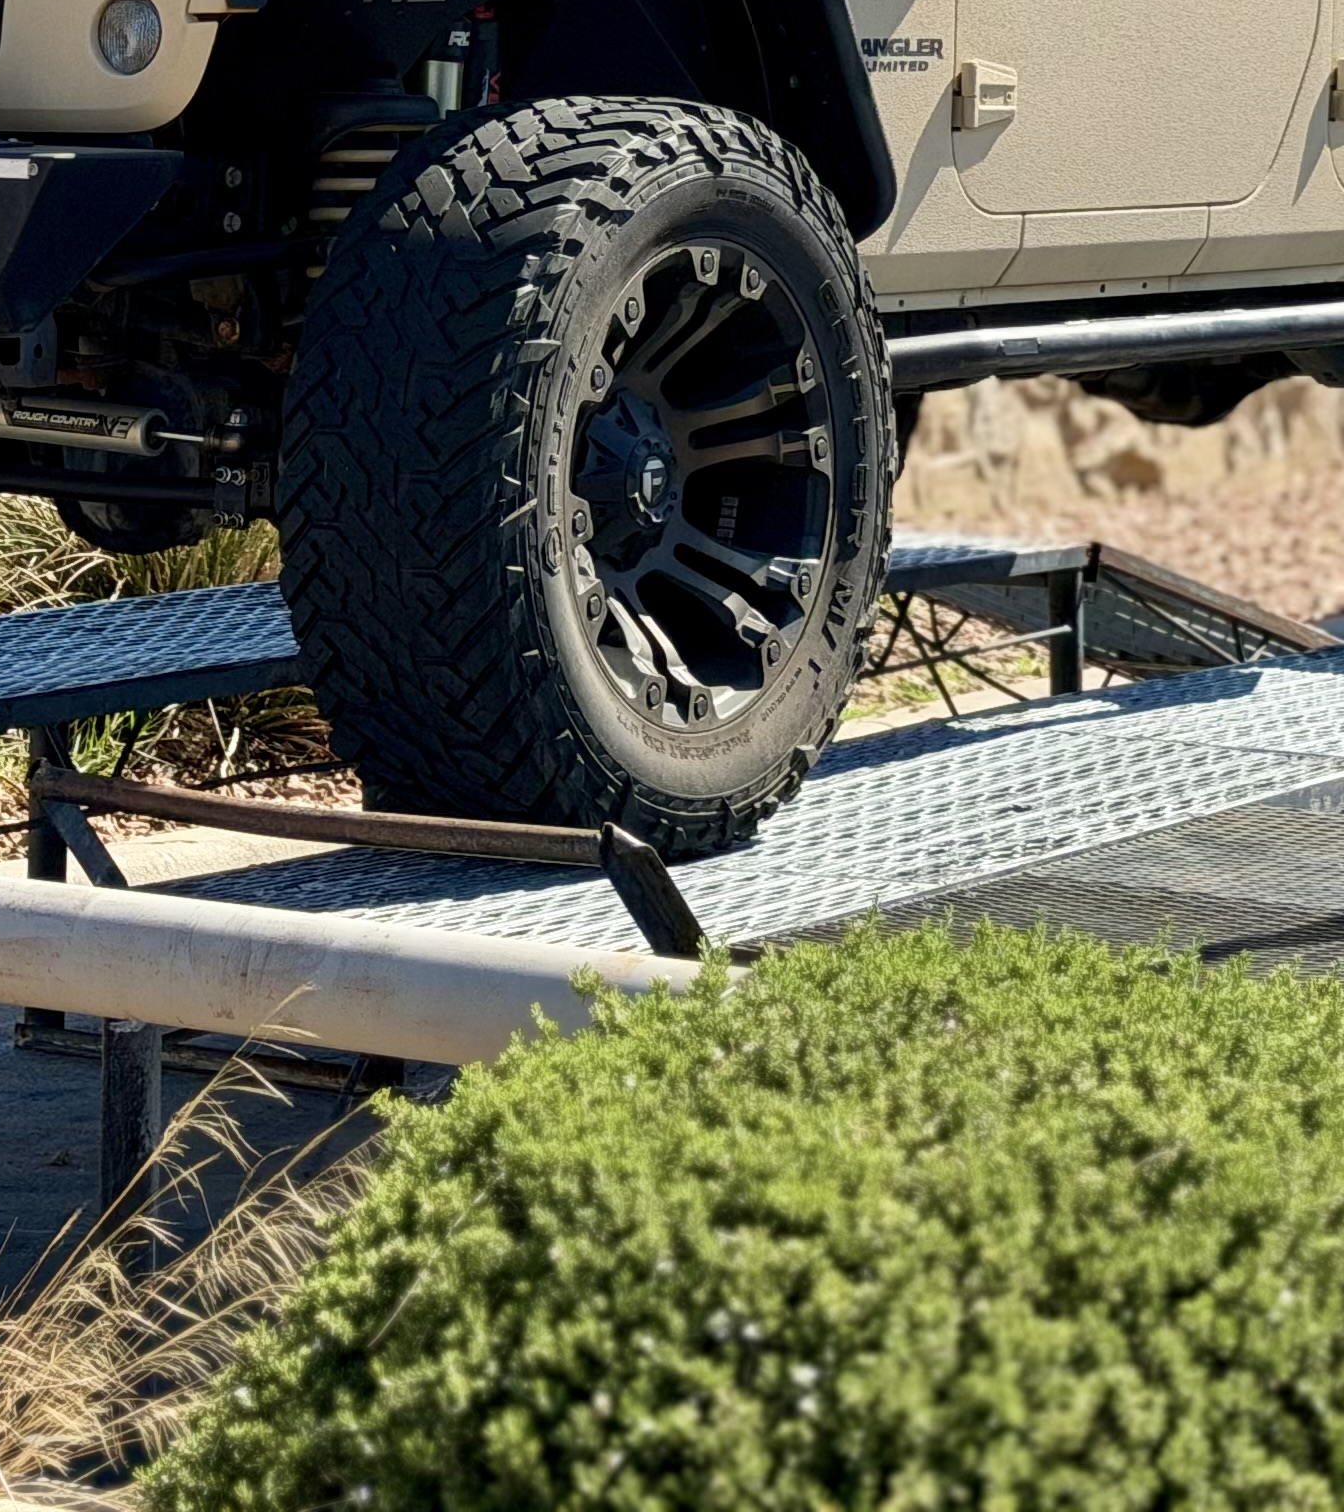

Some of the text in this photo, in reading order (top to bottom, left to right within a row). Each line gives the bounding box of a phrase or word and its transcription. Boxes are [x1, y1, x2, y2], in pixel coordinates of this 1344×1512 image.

[860, 38, 944, 59] ANGLER
[865, 60, 929, 72] LIMITED
[12, 410, 49, 422] ROUGH
[49, 414, 100, 428] COUNTRY
